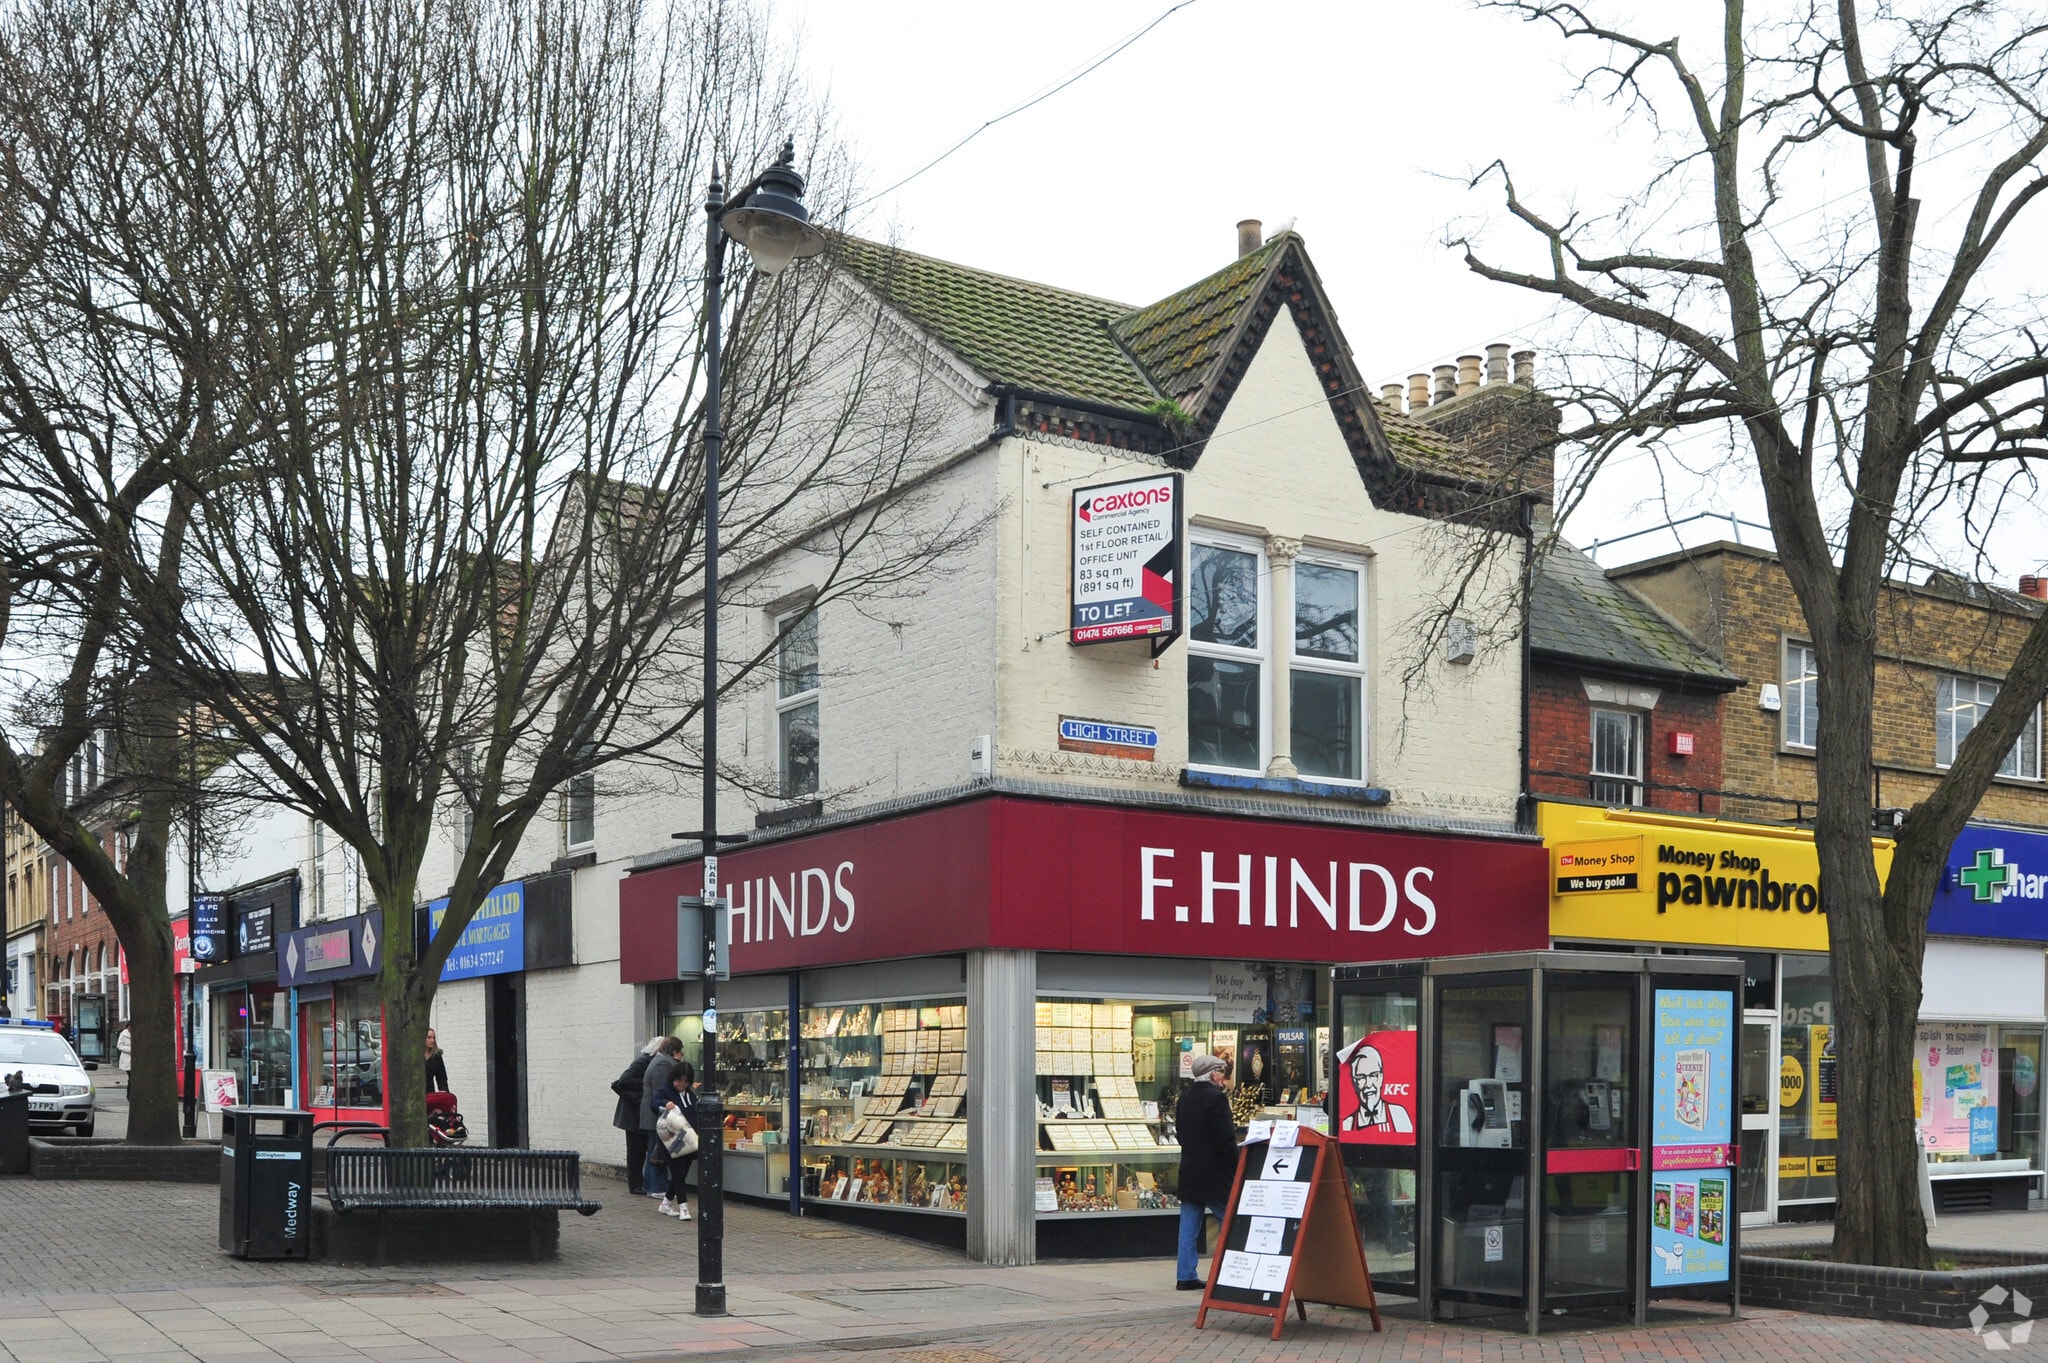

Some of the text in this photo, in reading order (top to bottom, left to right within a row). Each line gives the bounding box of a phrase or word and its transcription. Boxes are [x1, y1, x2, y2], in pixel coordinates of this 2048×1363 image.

[1092, 487, 1170, 513] caxtons
[1092, 507, 1150, 521] Commercial Agency
[1080, 519, 1160, 539] SELF CONTAINED
[1081, 543, 1094, 552] 1st
[1096, 537, 1128, 550] FLOOR
[1131, 532, 1163, 545] RETAIL
[1080, 550, 1138, 566] OFFICE UNIT
[1080, 567, 1122, 580] 83 sq m
[1079, 576, 1134, 595] (891 sq ft)
[1079, 602, 1133, 622] TO LET
[1077, 629, 1100, 640] 01474
[1102, 624, 1134, 637] 567666
[1069, 722, 1151, 745] HIGH STREET
[1561, 854, 1635, 867] The Money Shop
[1658, 844, 1761, 875] Money Shop
[1570, 876, 1626, 890] We buy gold
[502, 892, 520, 916] LTD
[468, 922, 511, 946] MORTGAGES
[460, 954, 478, 970] 01634
[480, 949, 504, 967] 577247
[1216, 974, 1245, 989] We buy
[708, 997, 716, 1006] 9
[1231, 990, 1263, 1004] jewellery
[1278, 1032, 1304, 1041] PULSAR
[1956, 1030, 1987, 1044] squeaky
[1676, 1062, 1704, 1074] QUEENIE
[1383, 1083, 1409, 1096] KFC
[39, 1102, 55, 1111] FPZ
[1973, 1117, 1994, 1131] Baby
[1972, 1132, 1994, 1144] Event
[284, 1181, 301, 1239] Medway
